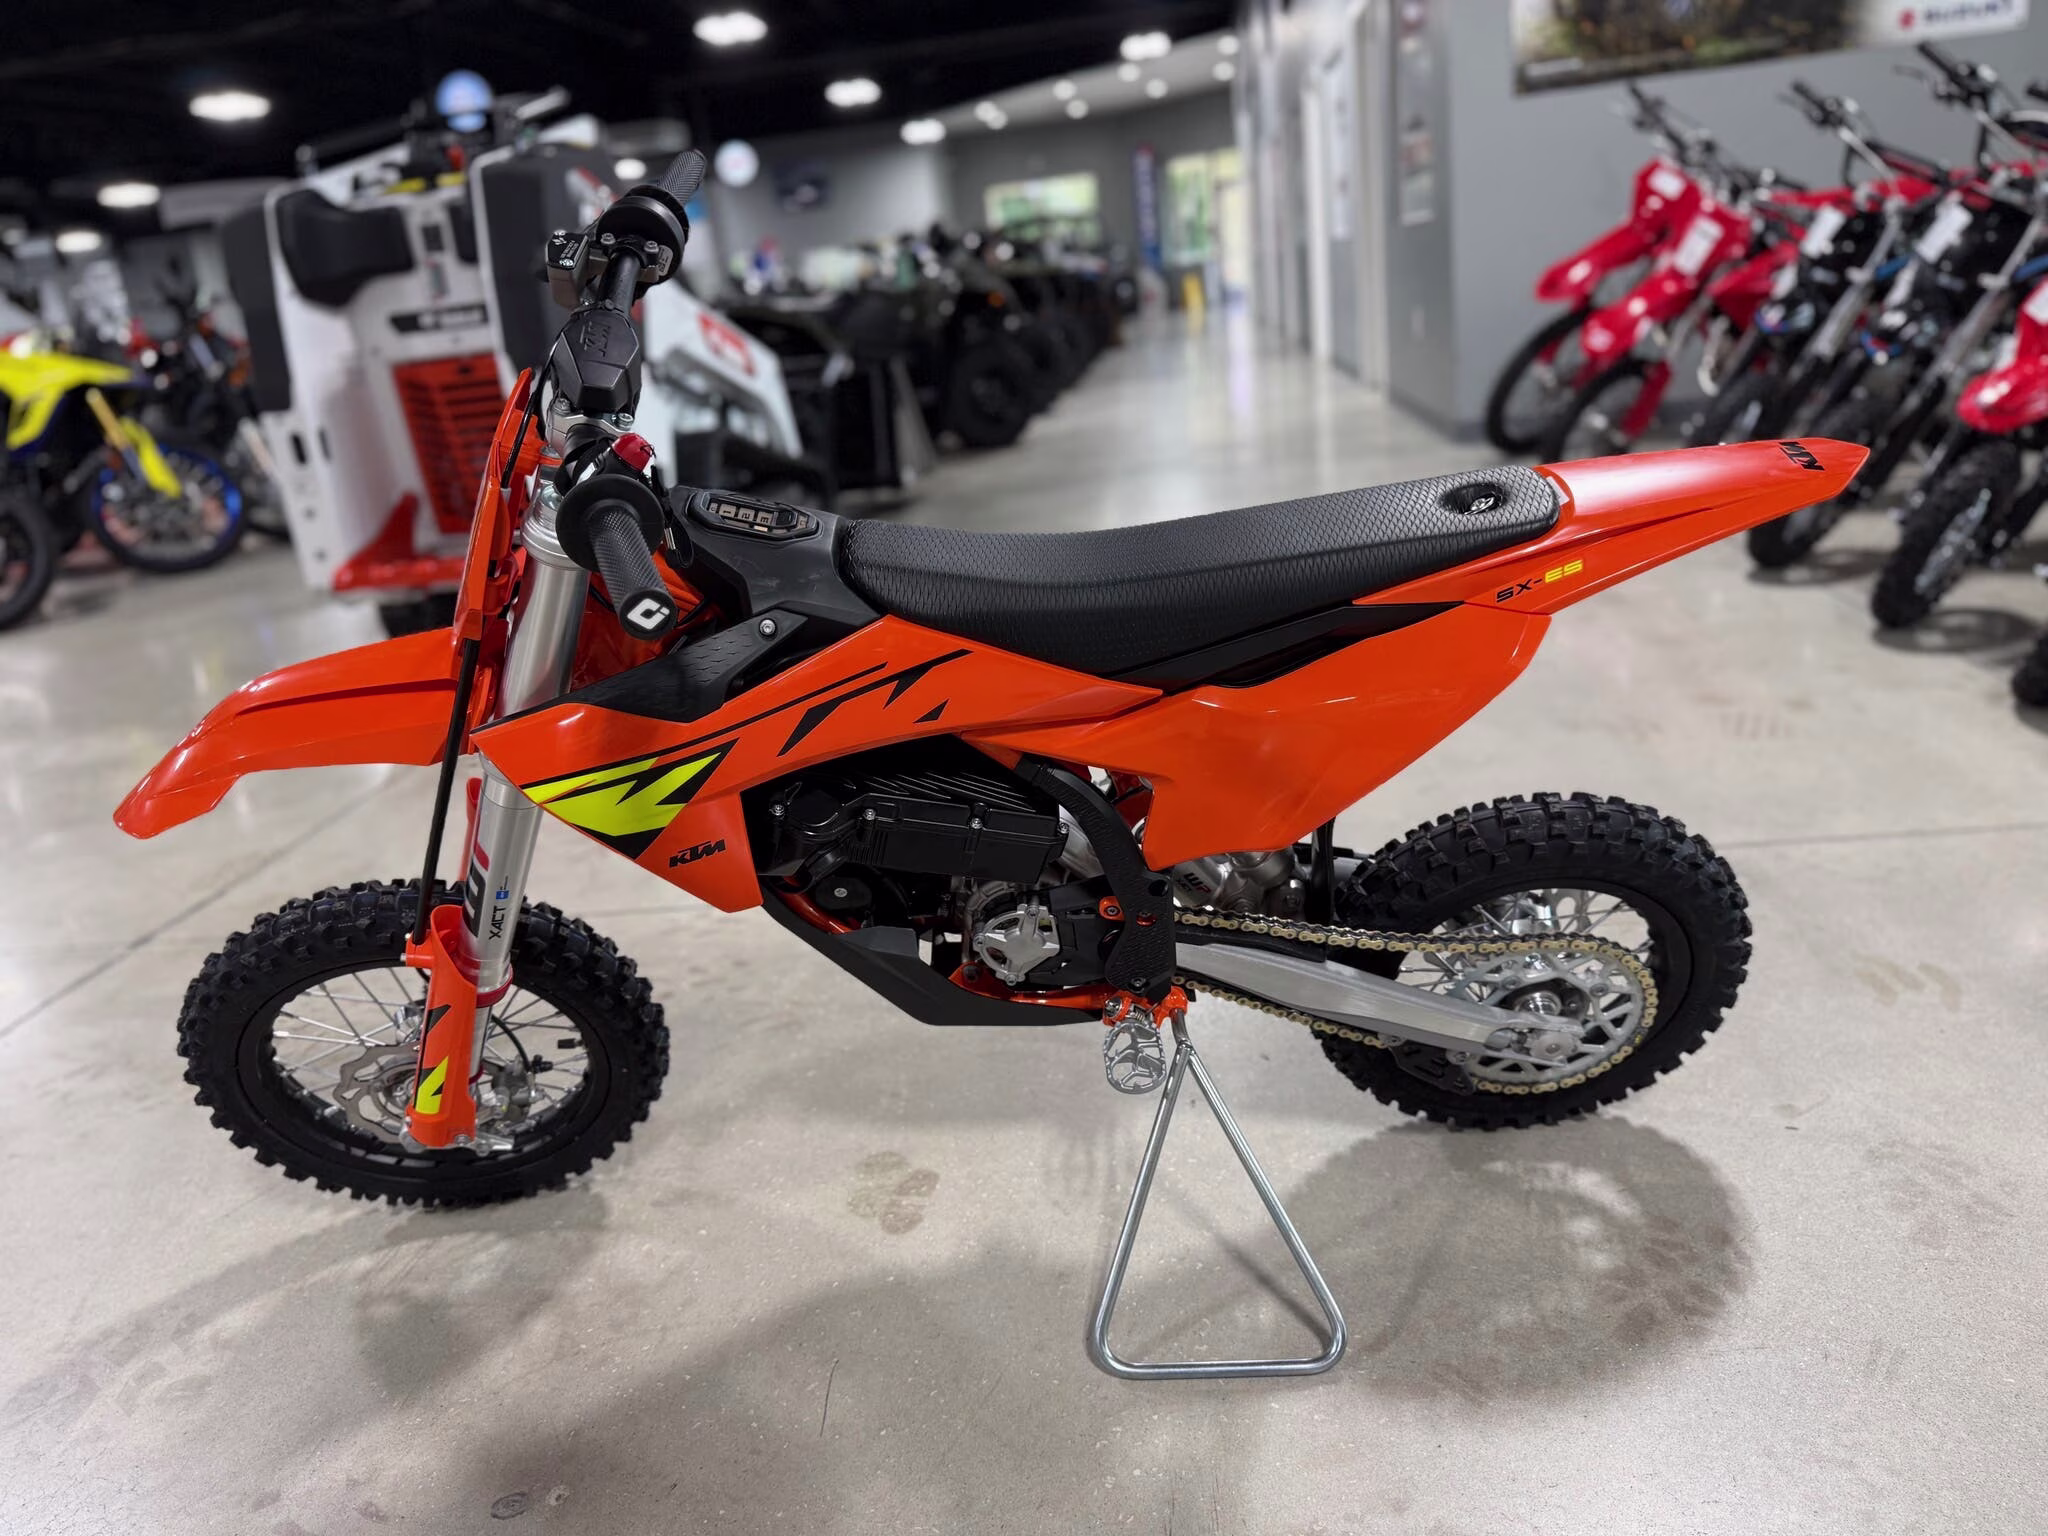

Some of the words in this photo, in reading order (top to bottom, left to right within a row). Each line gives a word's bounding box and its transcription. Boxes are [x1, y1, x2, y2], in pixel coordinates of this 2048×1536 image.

[1778, 441, 1825, 471] KTM
[1496, 559, 1583, 603] SX-ES
[669, 838, 726, 868] KTM
[489, 905, 507, 940] XACT
